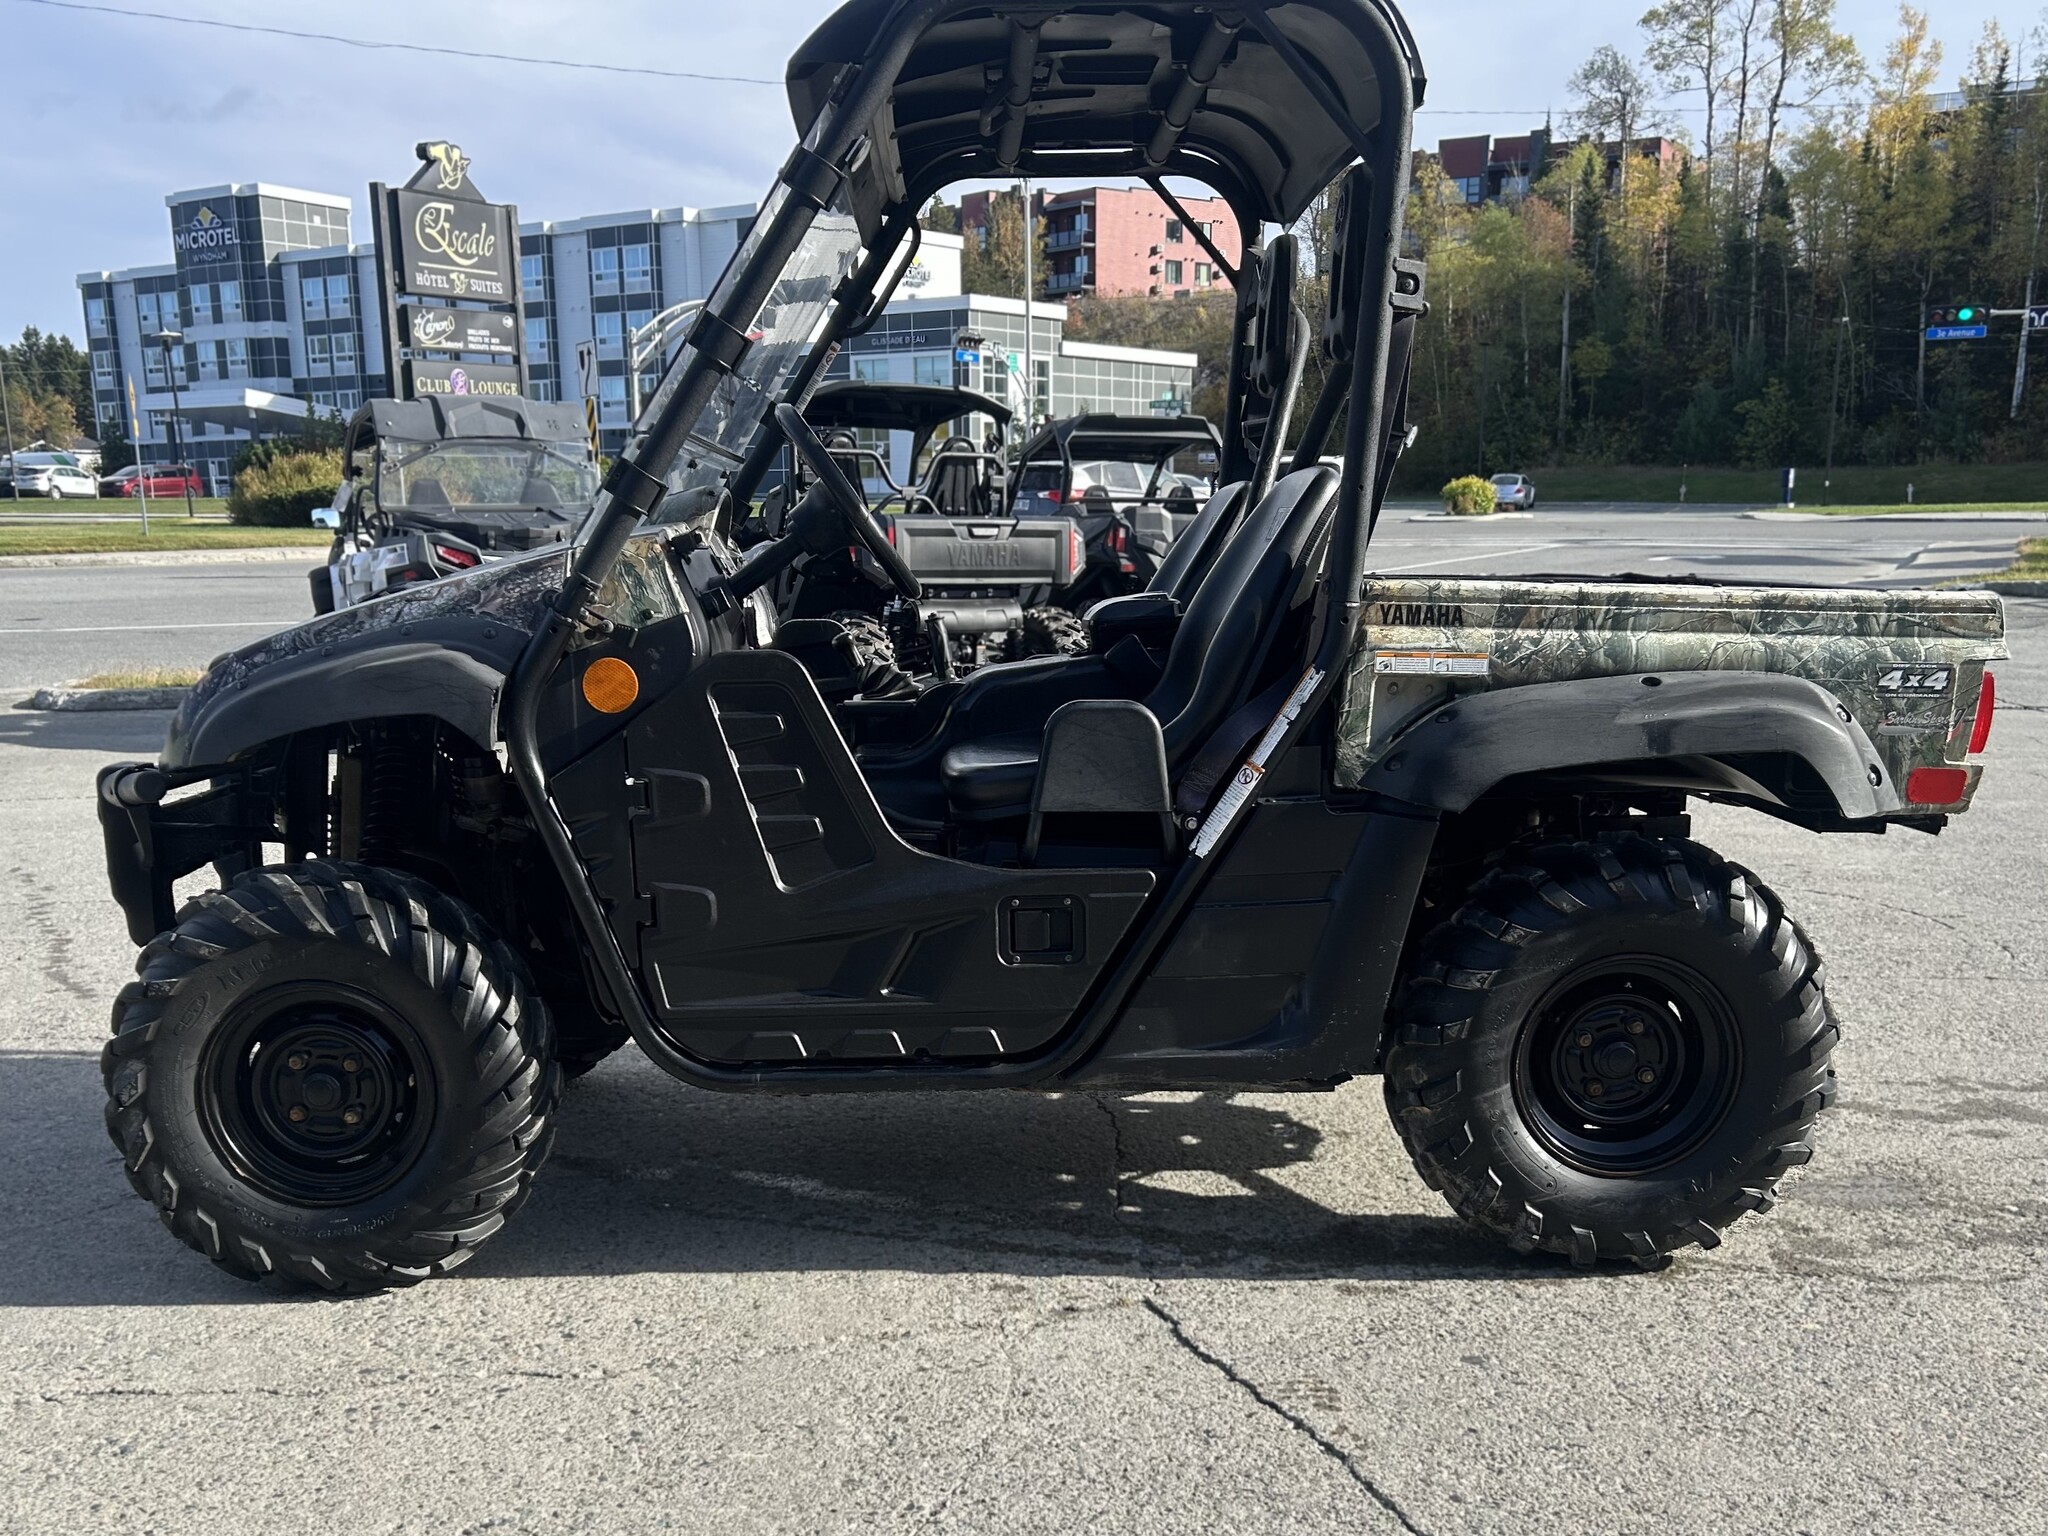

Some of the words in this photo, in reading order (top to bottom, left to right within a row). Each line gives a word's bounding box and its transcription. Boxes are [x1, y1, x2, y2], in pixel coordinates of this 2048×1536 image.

[175, 227, 240, 250] MICROTEL
[415, 269, 449, 288] HÔTEL
[470, 279, 503, 294] SUITES
[871, 336, 903, 346] GLISSADE
[905, 335, 926, 344] D'EAU
[1936, 330, 1946, 338] 3e
[1947, 329, 1976, 338] Avenue
[416, 376, 452, 393] CLUB
[469, 379, 518, 396] LOUNGE
[947, 543, 1021, 567] YAMAHA
[1380, 604, 1463, 625] YAMAHA
[1878, 669, 1950, 690] 4x4
